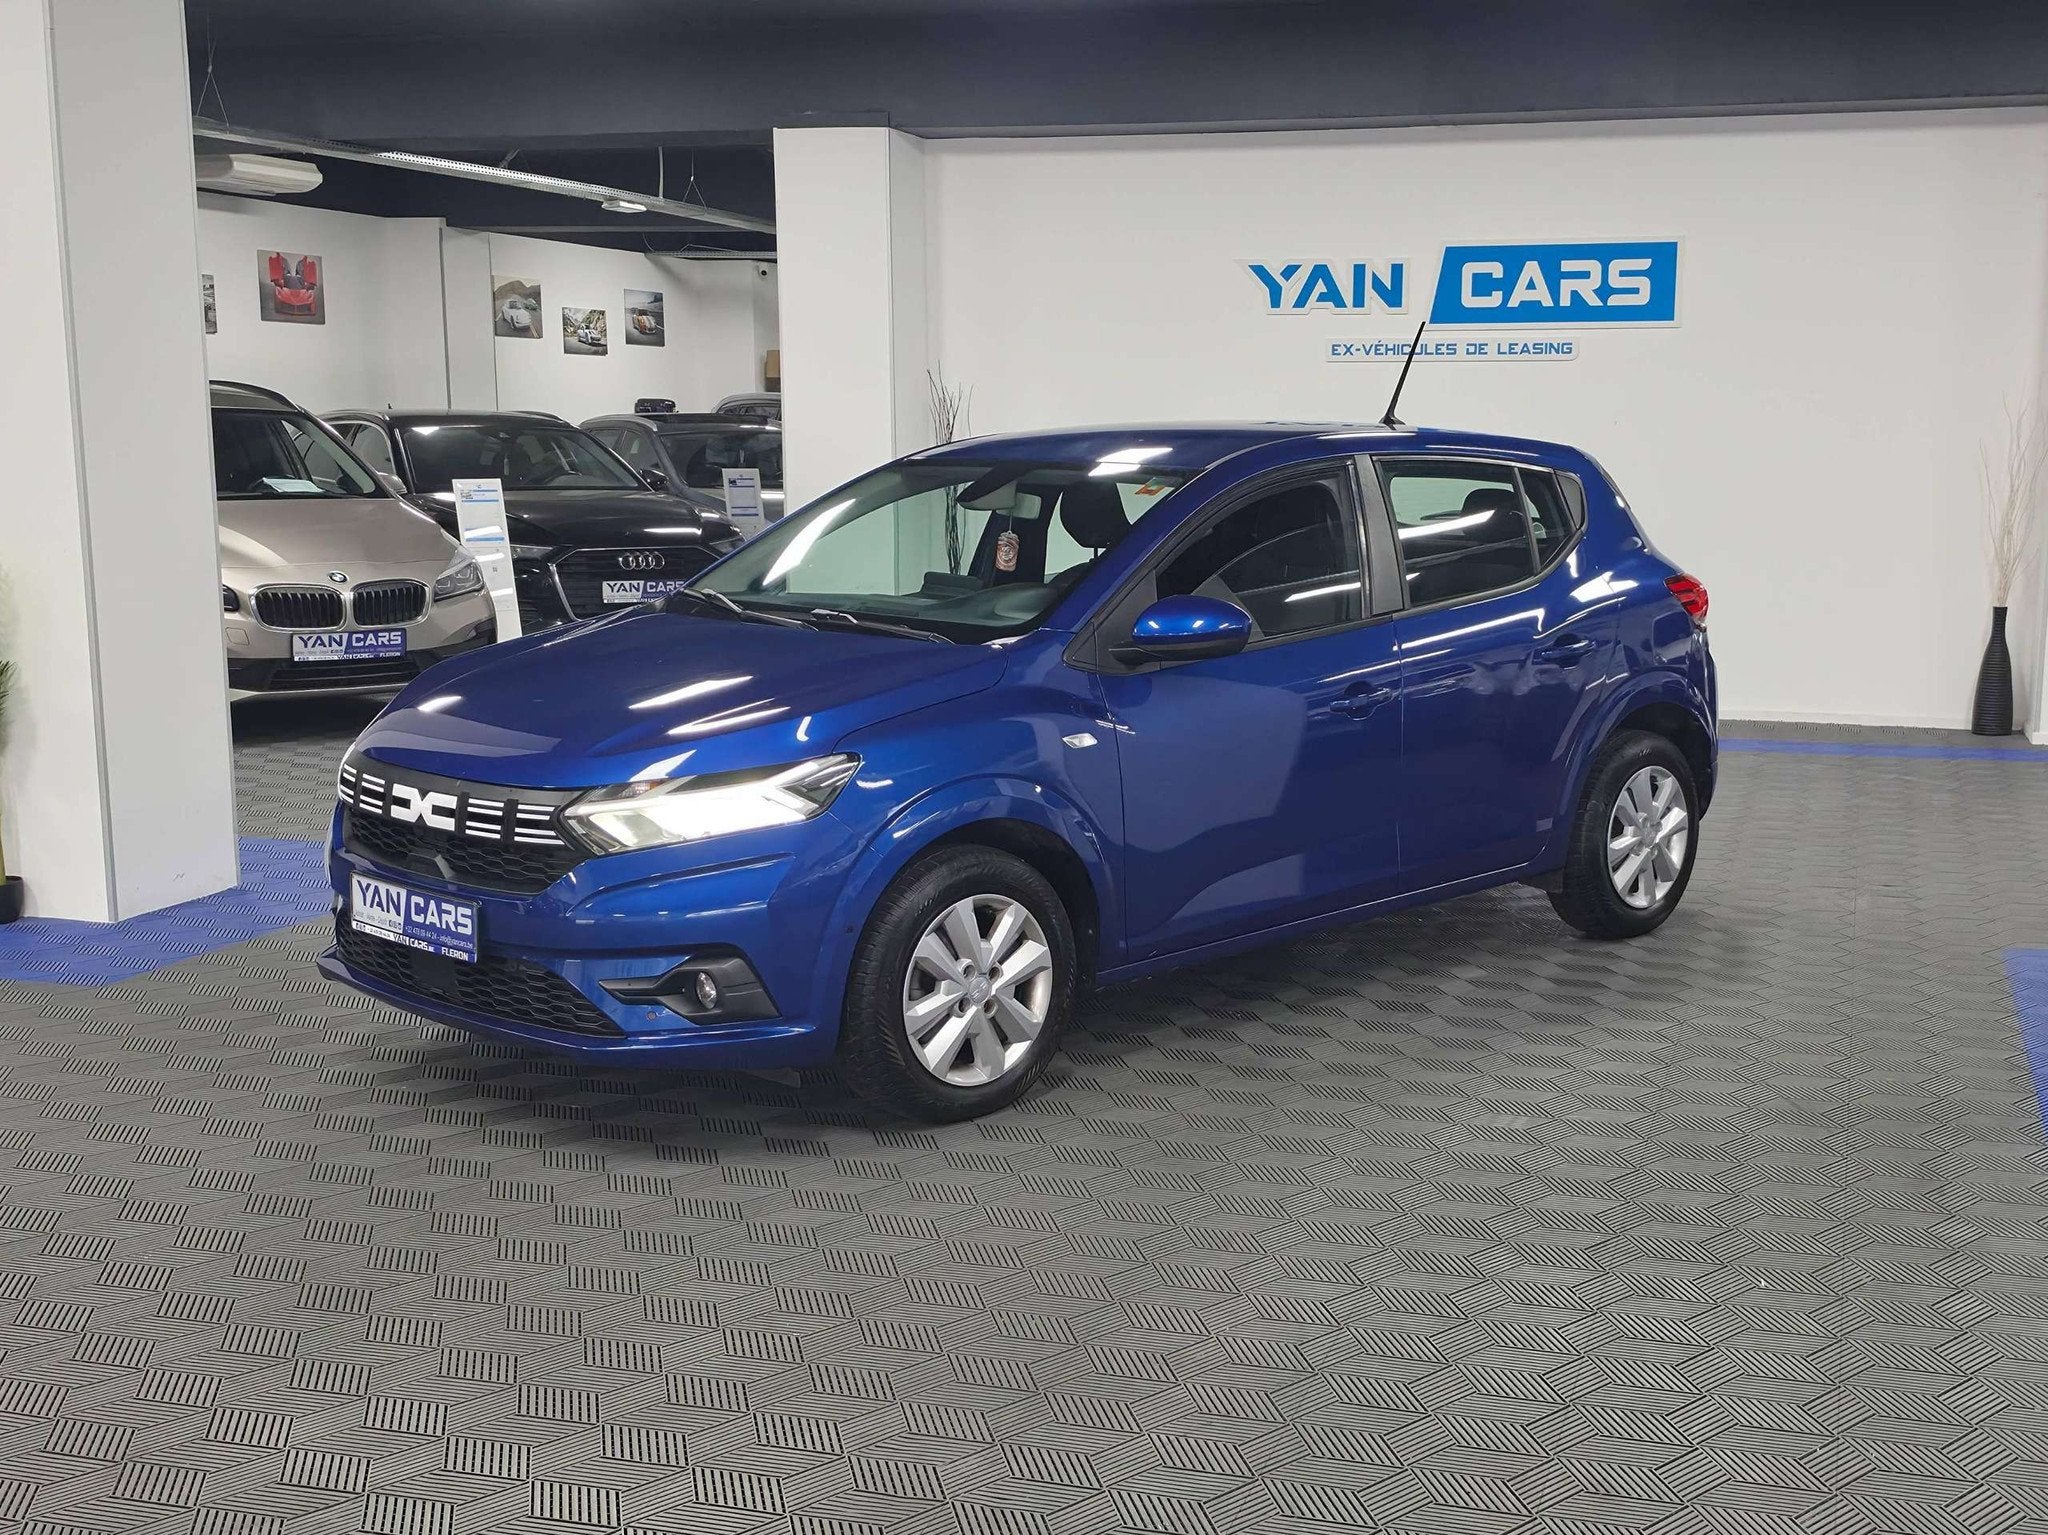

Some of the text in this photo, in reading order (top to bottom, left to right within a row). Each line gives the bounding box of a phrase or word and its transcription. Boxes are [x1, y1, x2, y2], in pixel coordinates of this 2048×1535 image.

[1248, 259, 1652, 309] YAN CARS
[1331, 340, 1573, 356] EX-VÉHICULES DE LEASING
[606, 582, 640, 593] YAN
[298, 632, 401, 649] YAN CARS
[357, 880, 401, 917] YAN
[411, 895, 472, 935] CARS
[441, 947, 469, 961] FLERON
